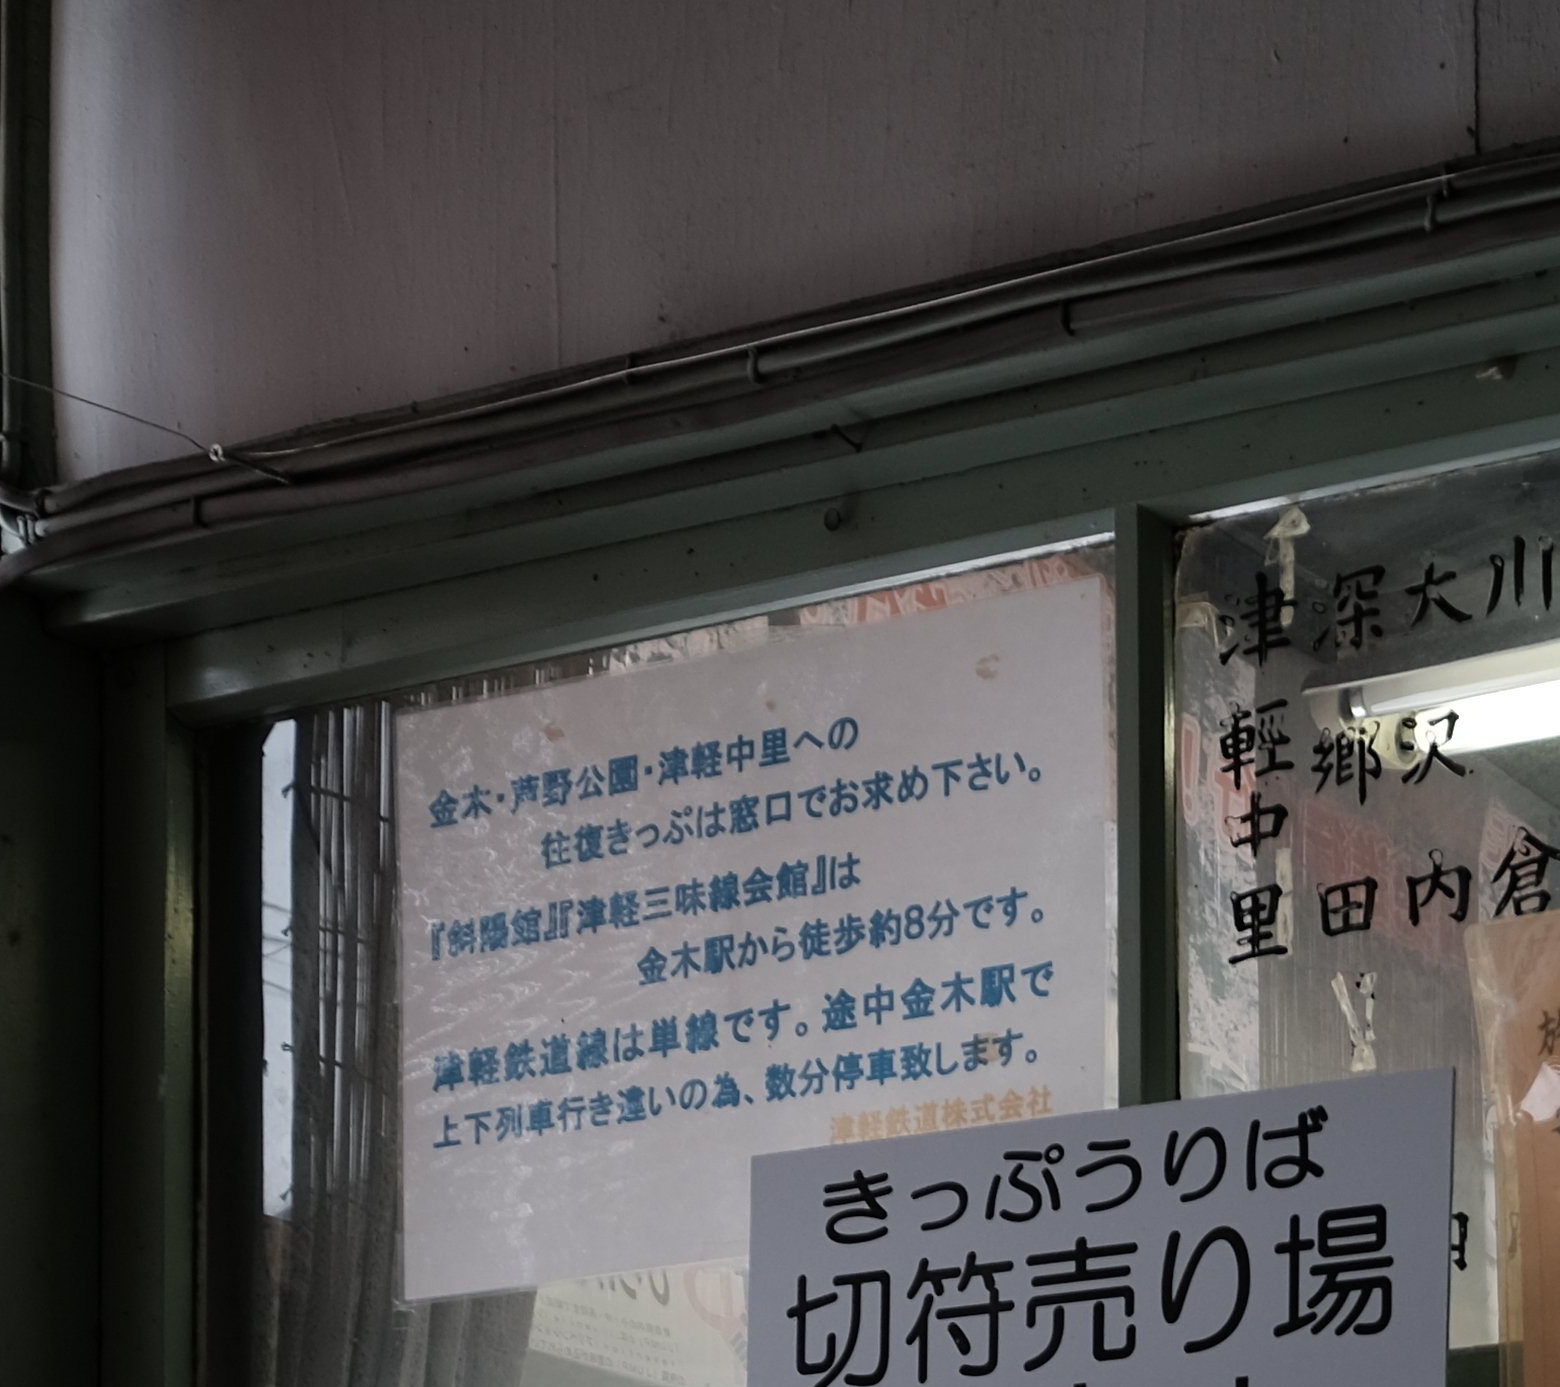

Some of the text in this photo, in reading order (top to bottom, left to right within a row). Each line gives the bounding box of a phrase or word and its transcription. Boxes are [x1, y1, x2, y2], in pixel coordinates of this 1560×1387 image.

[429, 716, 860, 828] 金木・芦野公園・津軽中里への
[1401, 562, 1473, 925] 大沢内
[542, 748, 1045, 869] 往復きっぷは窓口でお求め下さい。
[638, 887, 1046, 986] 金木駅から徒歩約8分です。
[432, 961, 1055, 1091] 津軽鉄道線は単線です。途中金木駅で
[432, 1029, 1040, 1150] 上下列車行き違いの為、数分停車致します。
[830, 1086, 1054, 1143] 津軽鉄道株式会社
[823, 1105, 1328, 1244] きっぷうりば
